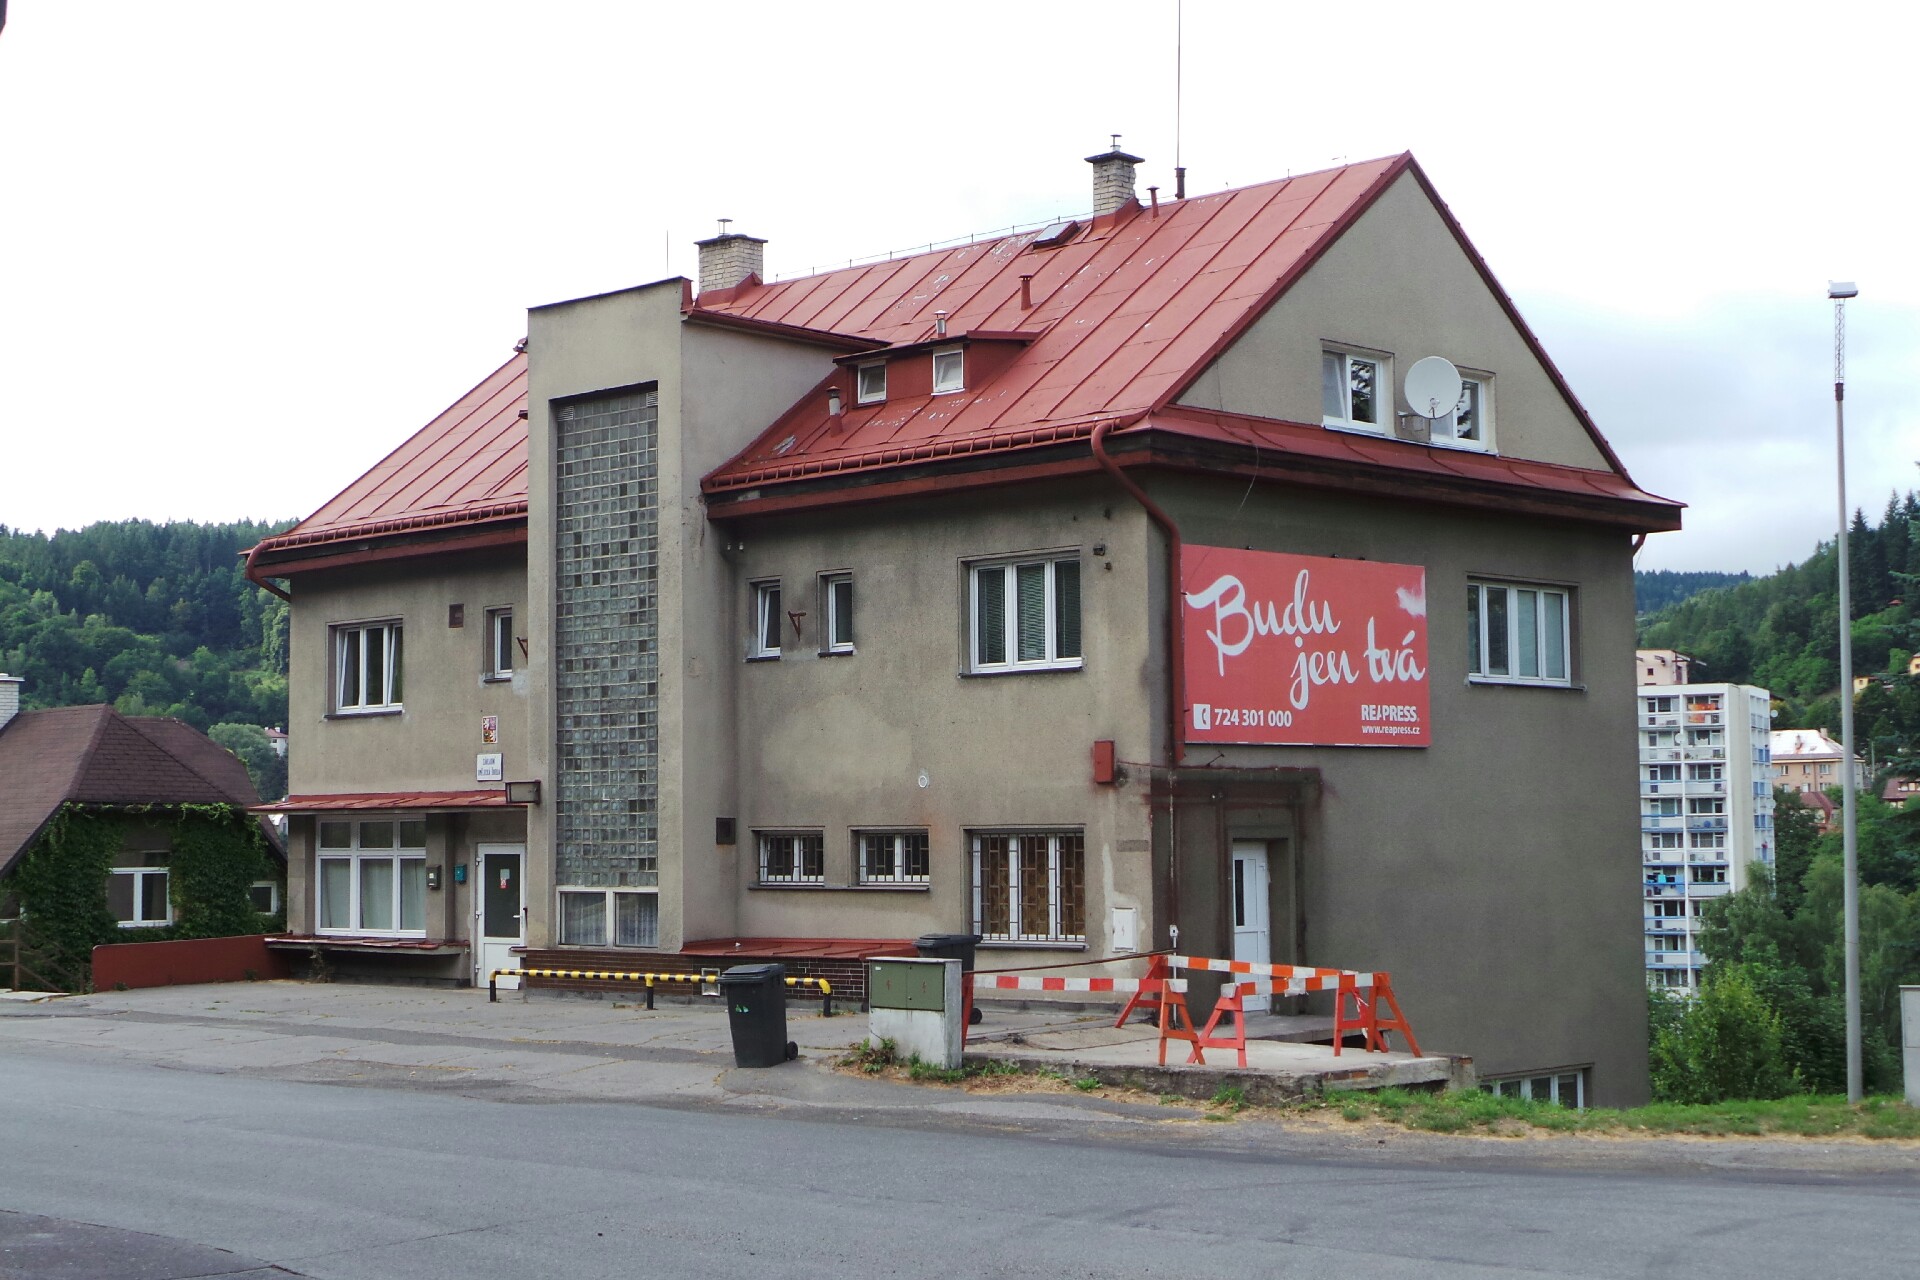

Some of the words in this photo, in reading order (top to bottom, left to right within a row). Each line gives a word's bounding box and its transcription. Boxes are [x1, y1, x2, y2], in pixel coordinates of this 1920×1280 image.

[1185, 569, 1341, 677] Budu
[1289, 636, 1359, 710] jen
[1363, 616, 1426, 682] tvá
[1214, 708, 1240, 726] 724
[1242, 709, 1264, 727] 301
[1268, 710, 1293, 728] 000
[1361, 725, 1420, 736] www.reapress.cz
